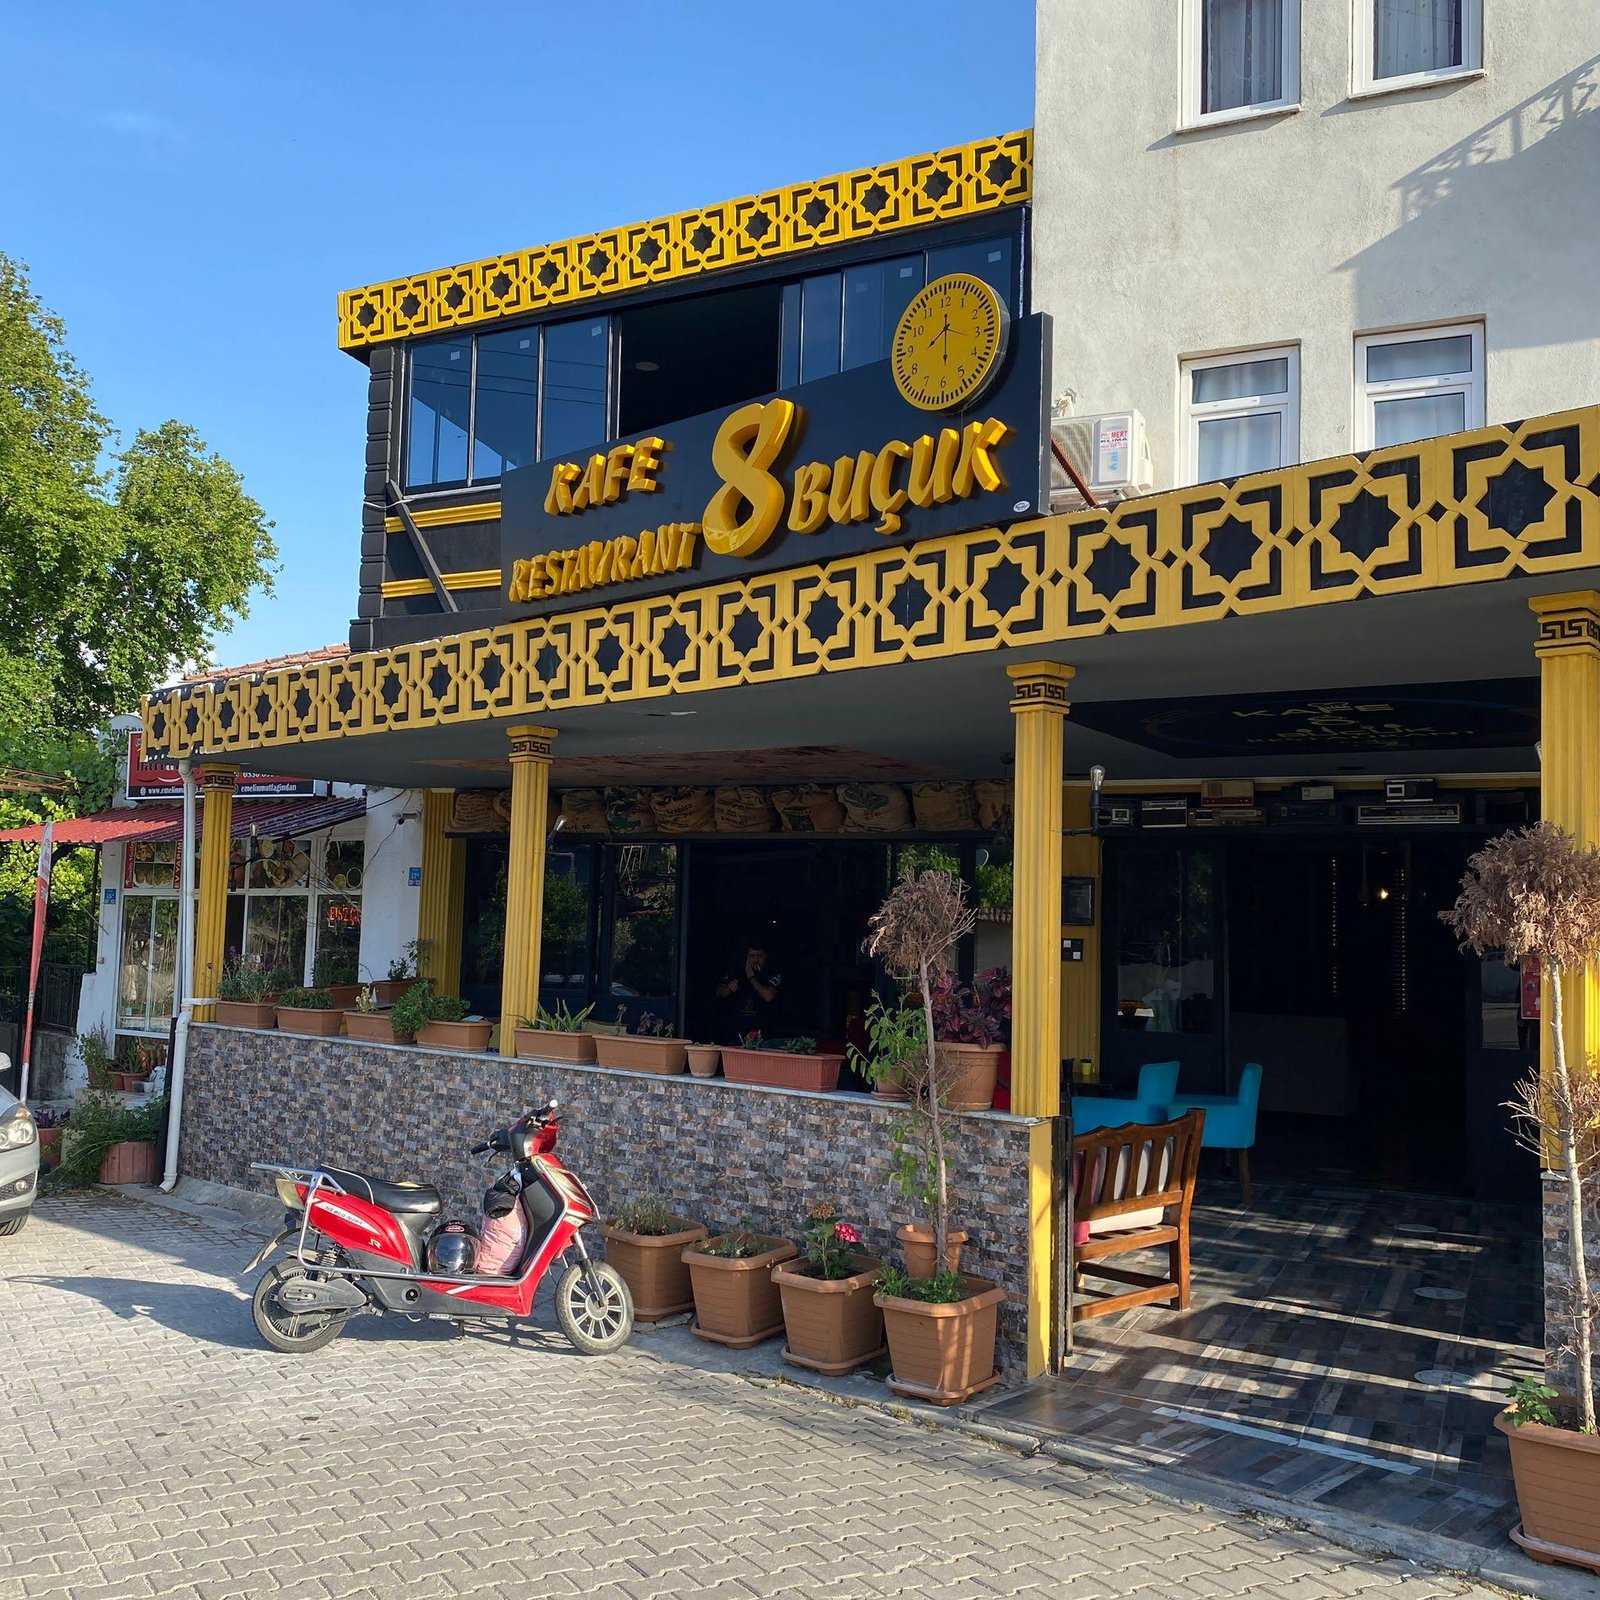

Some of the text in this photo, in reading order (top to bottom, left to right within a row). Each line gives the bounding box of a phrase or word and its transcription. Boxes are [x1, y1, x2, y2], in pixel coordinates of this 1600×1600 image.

[940, 296, 951, 308] 12
[960, 298, 965, 308] 1
[923, 307, 933, 319] 11
[971, 309, 978, 320] 2
[912, 325, 924, 337] 10
[975, 326, 981, 338] 3
[907, 345, 914, 357] 9
[971, 346, 977, 357] 4
[911, 363, 918, 375] 8
[957, 365, 965, 378] 5
[923, 375, 929, 387] 7
[940, 376, 947, 388] 6
[543, 436, 665, 515] KAFE
[702, 398, 795, 557] 8
[787, 417, 1007, 535] BUÇUK
[508, 522, 703, 602] RESTAURANT
